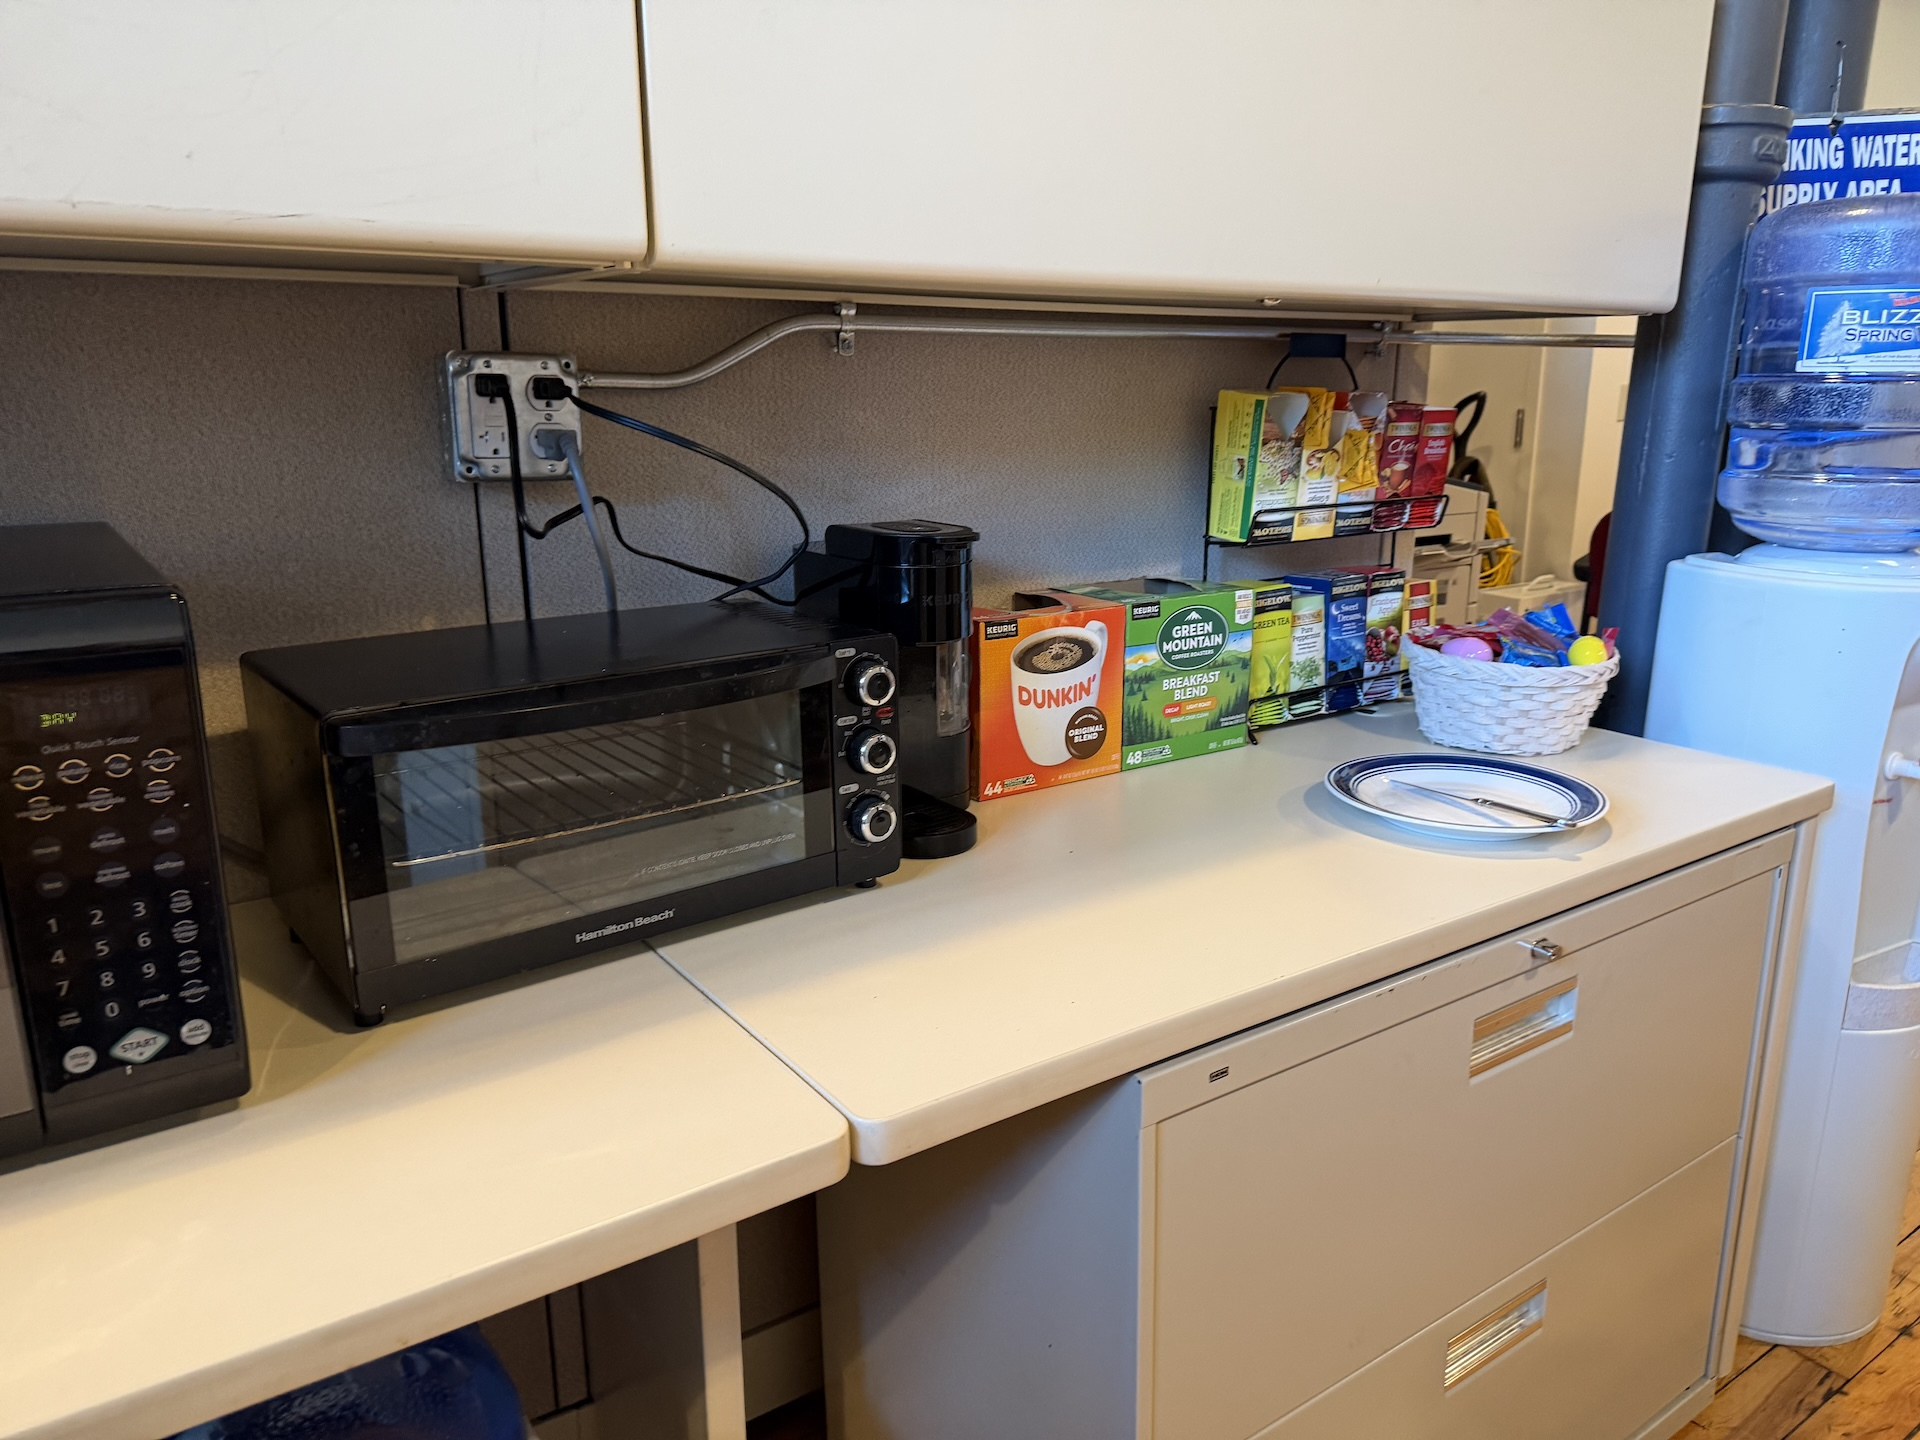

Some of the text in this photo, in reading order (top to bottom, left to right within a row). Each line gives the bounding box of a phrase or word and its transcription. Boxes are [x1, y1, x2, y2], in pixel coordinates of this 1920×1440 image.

[1852, 133, 1920, 168] WATER
[1255, 595, 1291, 608] BIGELOW
[1132, 604, 1159, 616] KEURIG
[986, 624, 1017, 635] KEURIG
[1172, 621, 1213, 638] GREEN
[1253, 617, 1290, 630] GREEN TEA
[1162, 634, 1223, 653] MOUNTAIN
[1171, 649, 1214, 661] COFFEE ROASTERS
[1162, 671, 1220, 690] BREAKFAST
[1018, 674, 1096, 709] DUNKIN'
[1174, 686, 1208, 701] BLEND
[1069, 724, 1104, 736] ORIGINAL
[1074, 732, 1098, 743] BLEND
[1126, 751, 1142, 765] 48
[983, 781, 1002, 796] 44
[132, 902, 146, 917] 3
[90, 910, 104, 925] 2
[47, 918, 58, 933] 1
[575, 910, 674, 943] Hamilton Beach
[137, 932, 152, 947] 6
[95, 941, 110, 956] 5
[51, 949, 67, 964] 4
[142, 963, 156, 978] 9
[100, 971, 115, 987] 8
[56, 980, 69, 997] 7
[105, 1002, 119, 1017] 0
[121, 1036, 158, 1052] START
